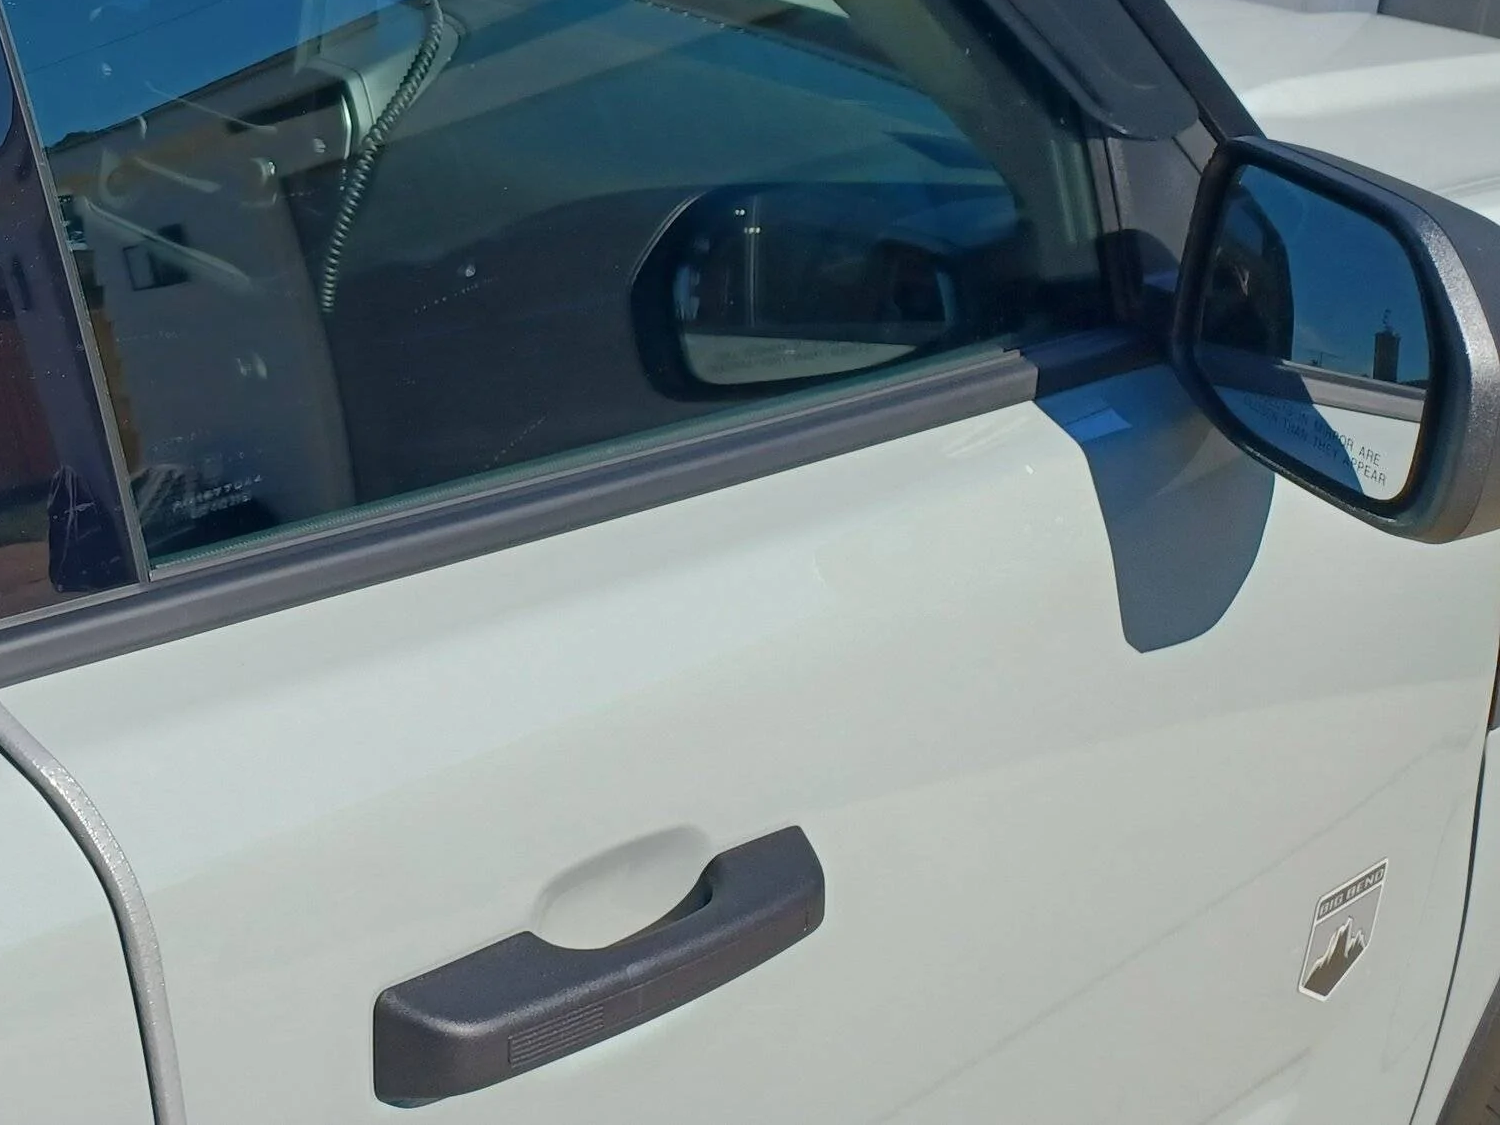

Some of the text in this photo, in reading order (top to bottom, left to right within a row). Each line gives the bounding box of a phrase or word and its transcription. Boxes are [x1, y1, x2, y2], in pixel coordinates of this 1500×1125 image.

[1342, 454, 1387, 487] APPEAR
[1358, 446, 1382, 467] ARE
[1319, 868, 1384, 917] BIG BEND
